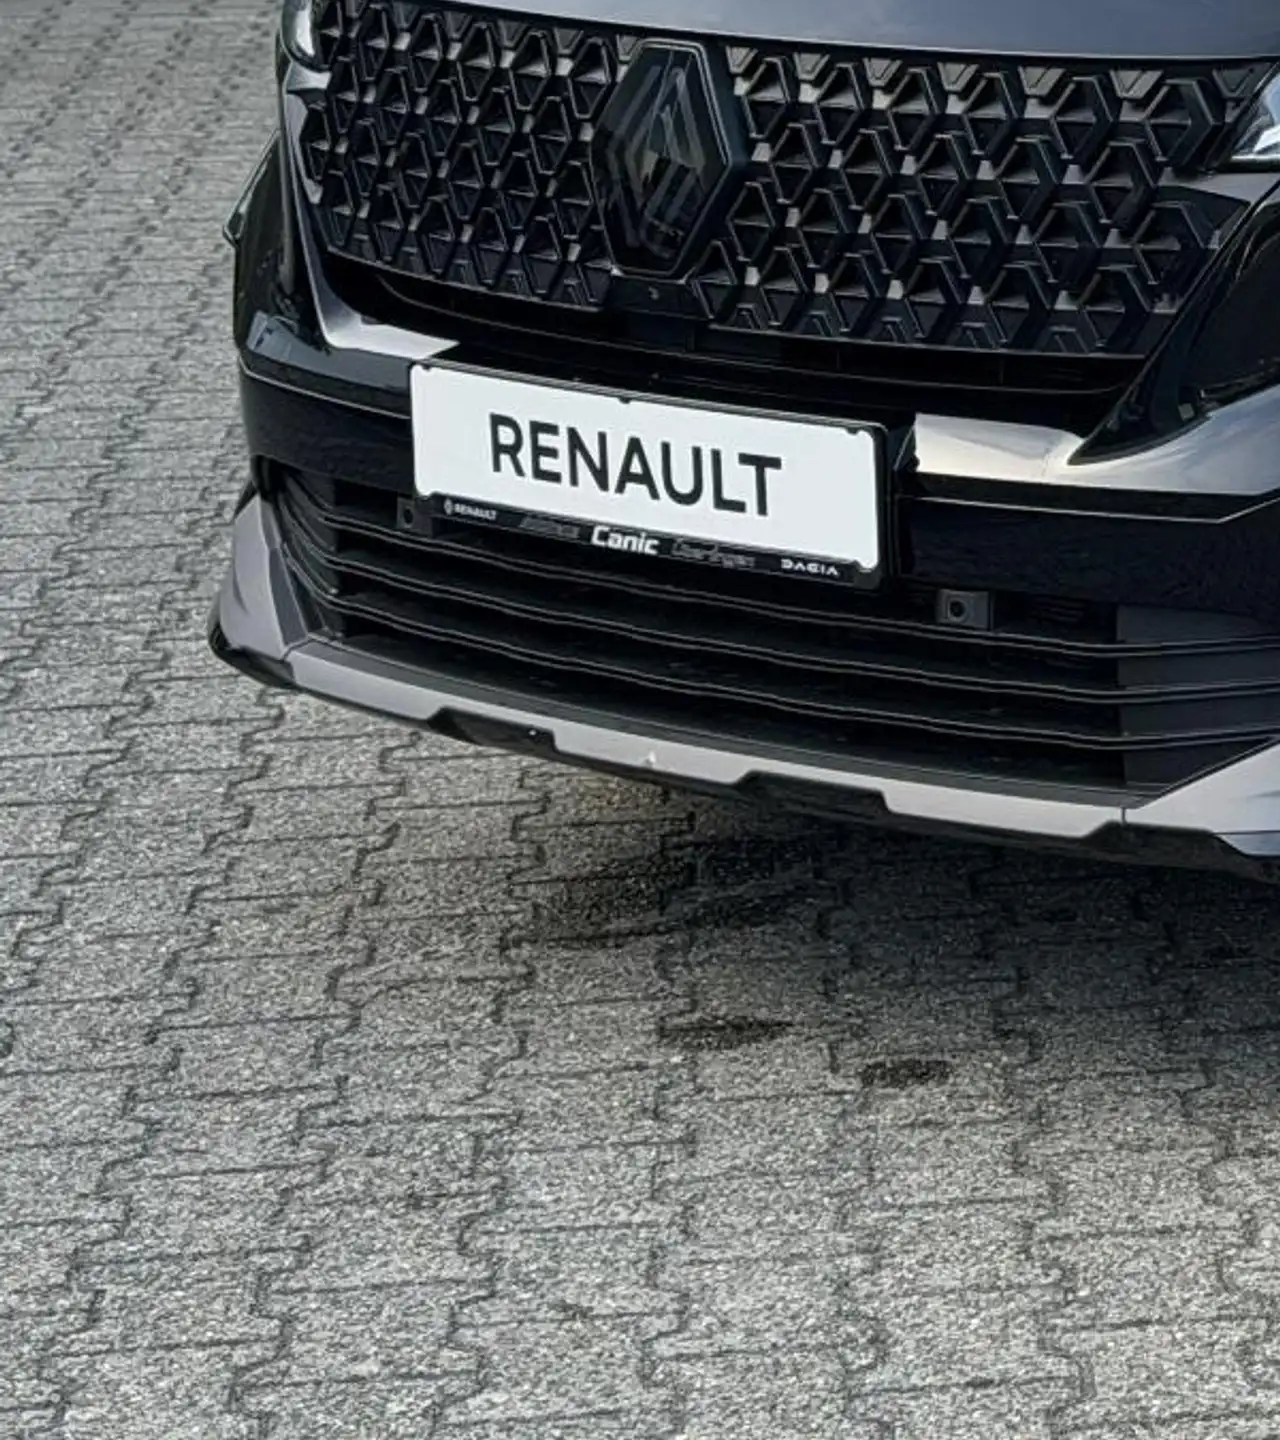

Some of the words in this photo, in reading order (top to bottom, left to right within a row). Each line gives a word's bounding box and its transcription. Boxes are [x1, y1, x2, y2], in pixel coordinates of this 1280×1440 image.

[489, 413, 783, 516] RENAULT
[591, 525, 660, 555] Canic
[780, 558, 840, 577] DACIA
